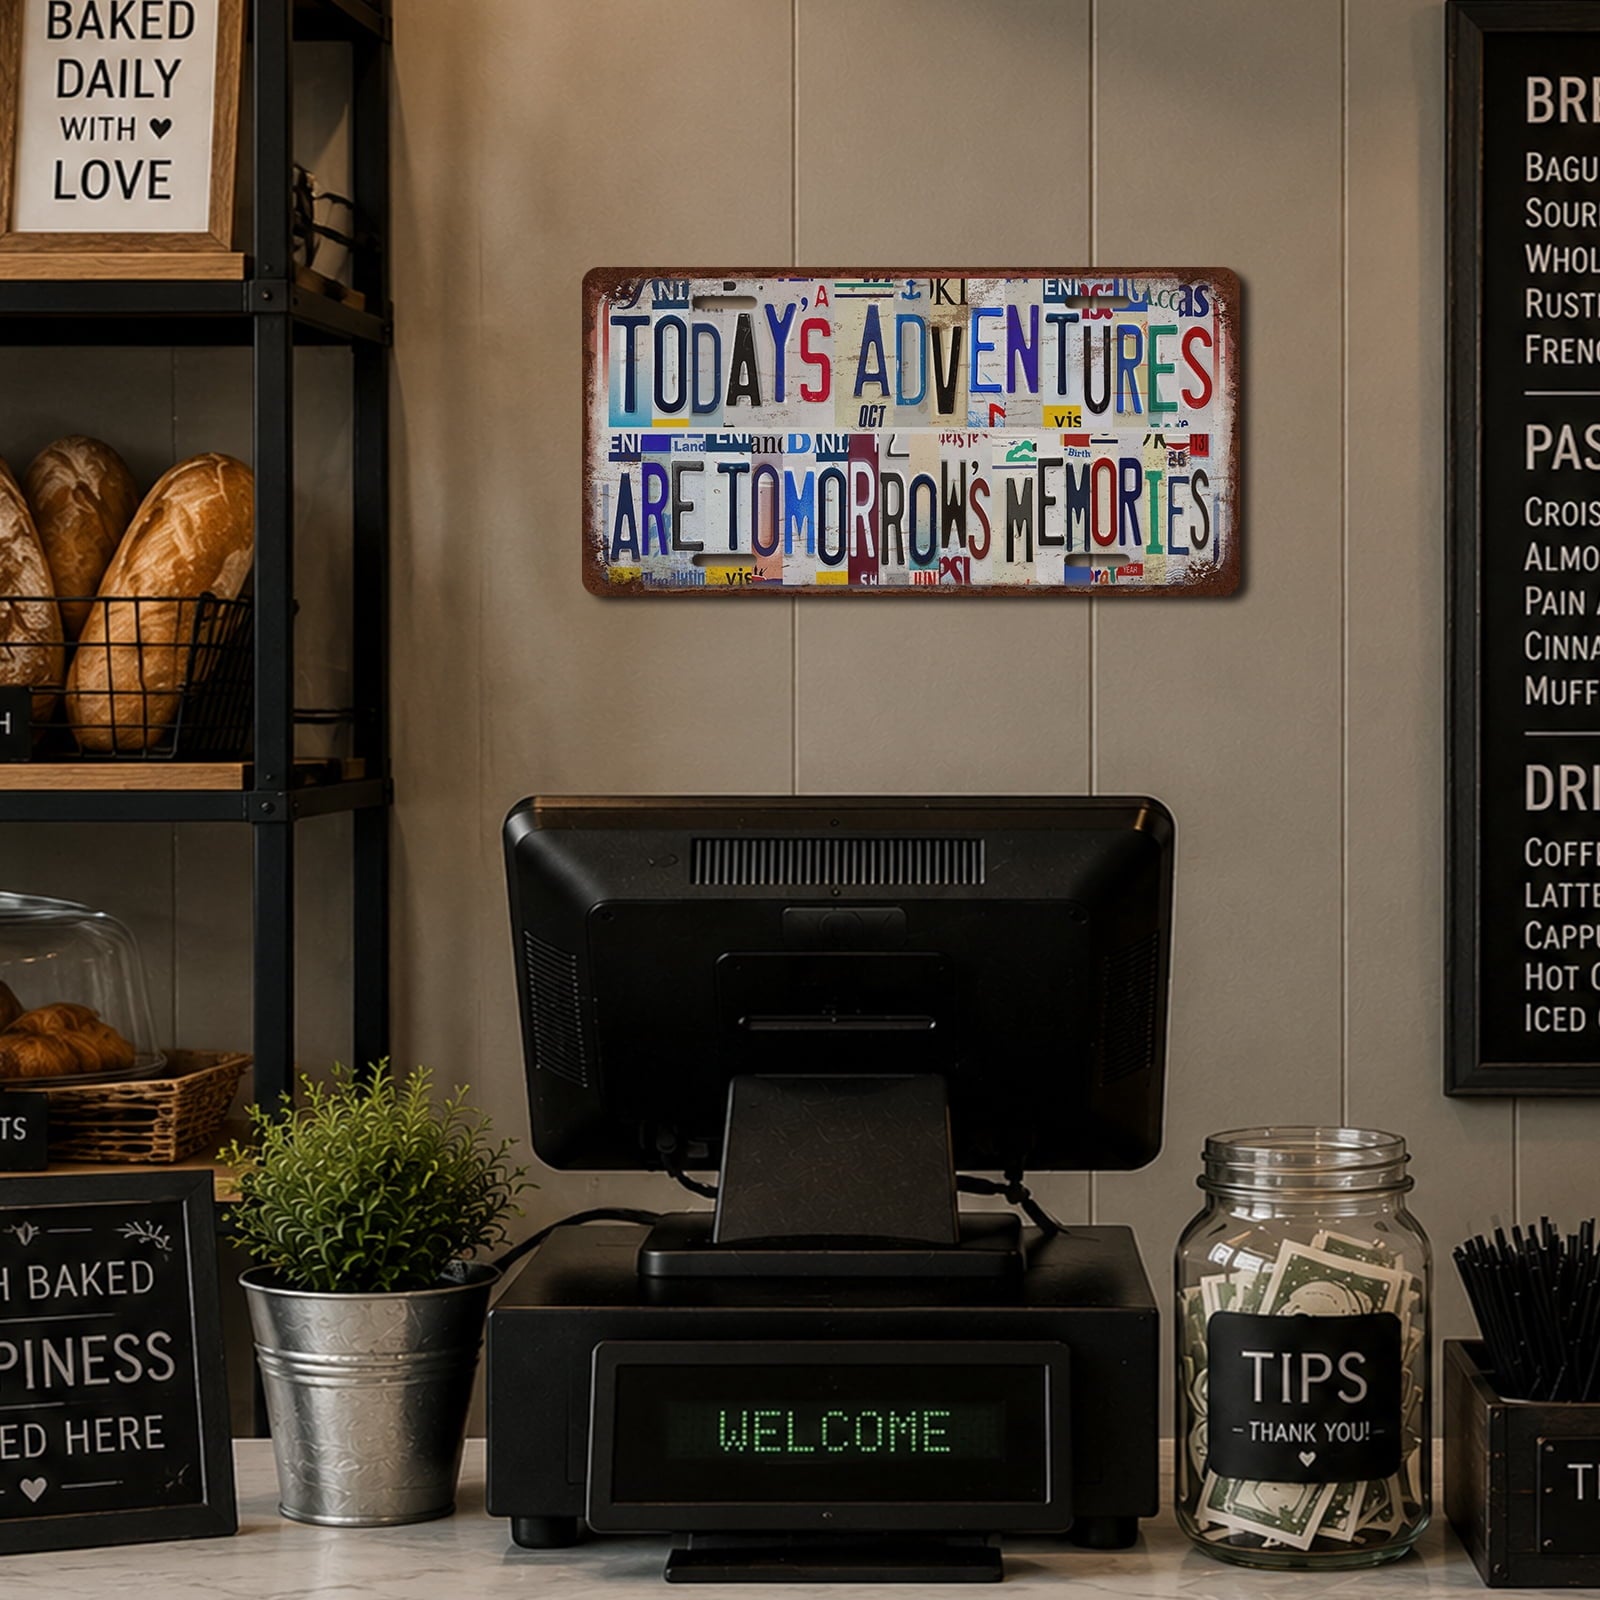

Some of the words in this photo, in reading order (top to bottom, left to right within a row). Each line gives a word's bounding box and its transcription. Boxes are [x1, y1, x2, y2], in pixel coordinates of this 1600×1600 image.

[48, 0, 195, 40] BAKED
[57, 58, 182, 99] DAILY
[60, 116, 136, 141] WITH
[54, 159, 172, 200] LOVE
[1525, 197, 1600, 228] SOUR
[609, 296, 831, 414] TODAY'S
[853, 303, 1213, 415] ADVENTURES
[1526, 334, 1600, 364] FREN
[858, 404, 887, 427] OCT
[610, 460, 704, 562] ARE
[716, 459, 991, 566] TOMORROW'S
[1006, 457, 1210, 563] MEMORIES
[1525, 496, 1600, 527] CROIS
[1524, 541, 1600, 572] ALMO
[1525, 585, 1585, 616] PAIN
[1525, 675, 1600, 706] MUFF
[1525, 837, 1600, 867] COFF
[1525, 920, 1600, 950] CAPP
[1525, 962, 1580, 991] HOT
[1525, 1003, 1586, 1032] ICED
[28, 1260, 154, 1300] BAKED
[1241, 1351, 1368, 1404] TIPS
[65, 1415, 165, 1455] HERE
[719, 1410, 951, 1452] WELCOME
[1249, 1421, 1317, 1443] THANK
[1324, 1421, 1371, 1442] YOU!
